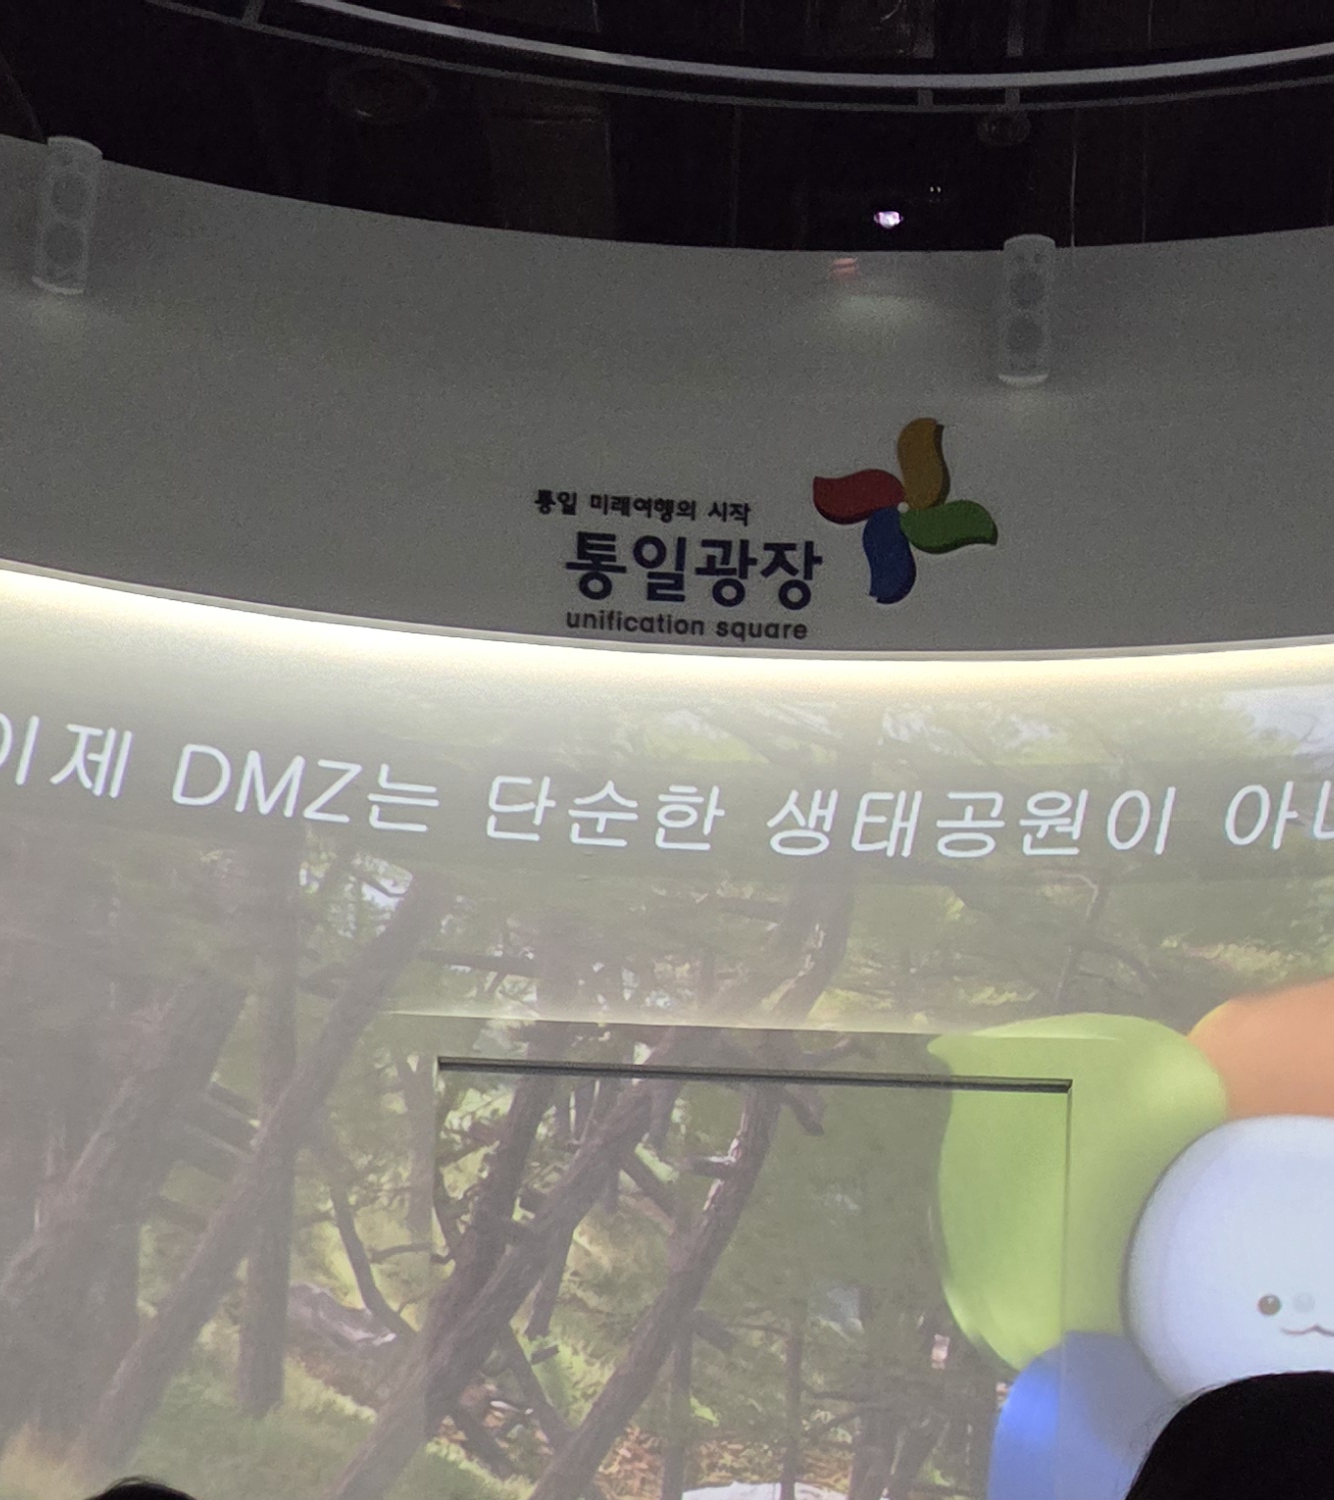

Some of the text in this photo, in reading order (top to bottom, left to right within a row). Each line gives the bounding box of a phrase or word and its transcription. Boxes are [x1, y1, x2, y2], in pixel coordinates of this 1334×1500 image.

[534, 489, 752, 526] 통일 미래여행의 시작
[565, 530, 823, 610] 통일광장
[567, 610, 808, 643] unification square
[171, 743, 440, 832] DMZ는
[486, 774, 726, 851] 단순한
[767, 785, 1177, 858] 생태공원이
